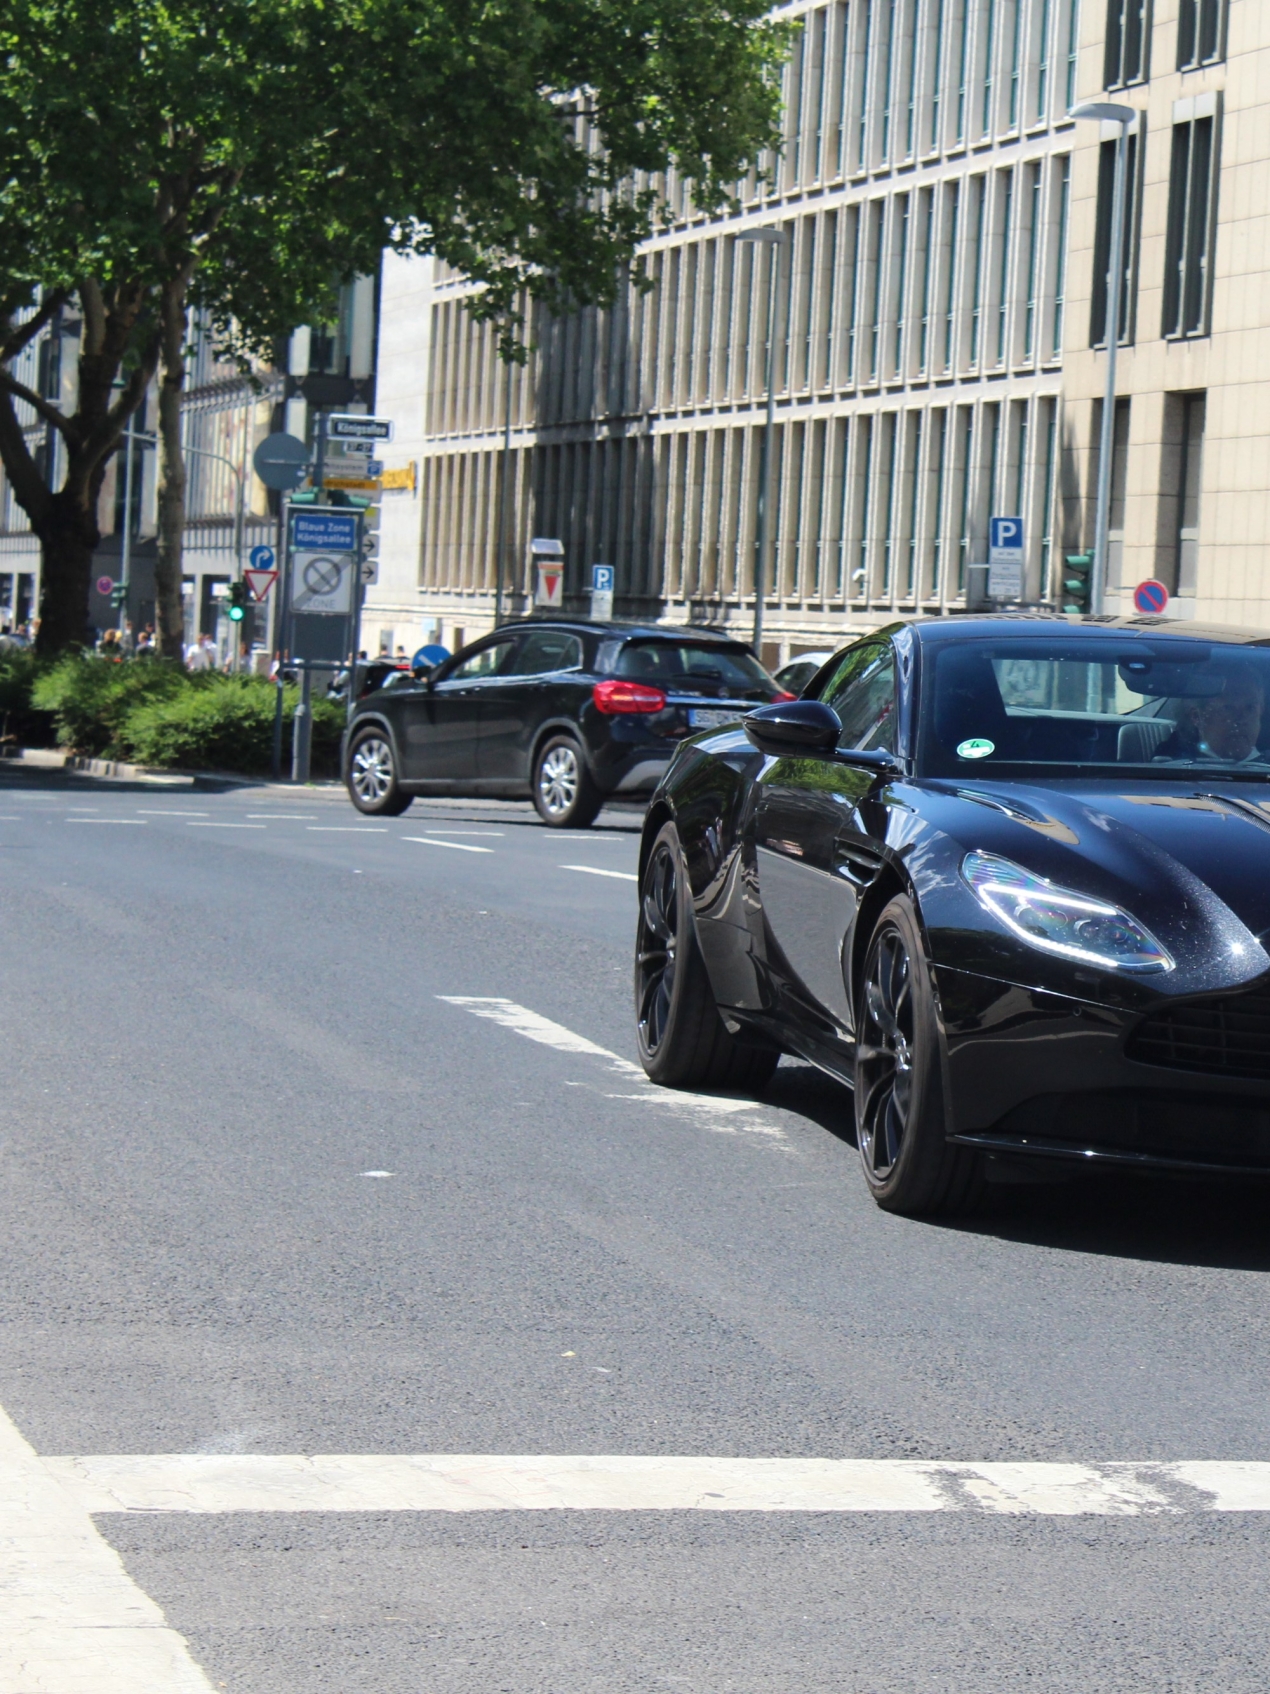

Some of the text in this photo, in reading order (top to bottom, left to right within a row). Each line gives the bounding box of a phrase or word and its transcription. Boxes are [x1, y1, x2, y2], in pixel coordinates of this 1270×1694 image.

[298, 521, 351, 533] Blaue Zone
[997, 520, 1017, 547] P
[297, 532, 351, 545] Königsallee
[597, 568, 610, 589] P
[970, 740, 980, 748] 4
